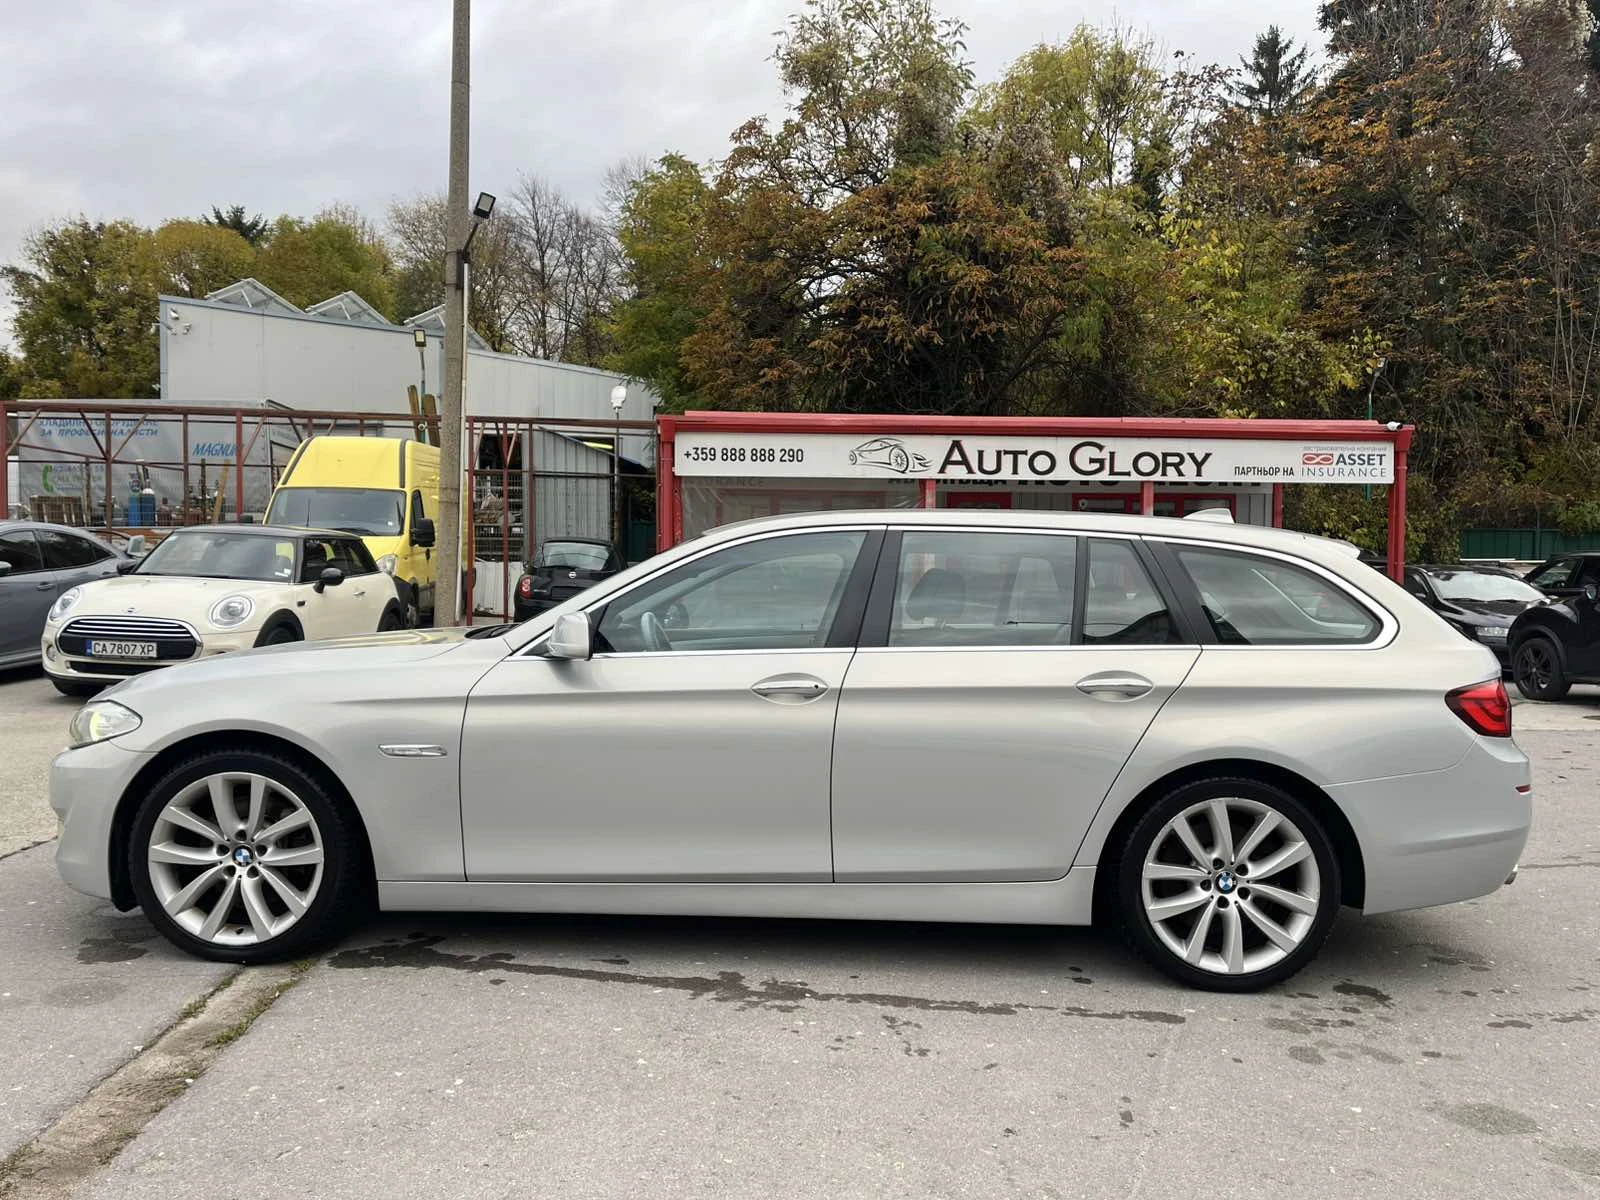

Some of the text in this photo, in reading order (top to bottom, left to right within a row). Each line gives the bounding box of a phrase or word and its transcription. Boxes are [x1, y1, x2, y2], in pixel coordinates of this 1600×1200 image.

[683, 447, 804, 463] +359 888 888 290
[1335, 452, 1387, 466] ASSET
[1234, 466, 1295, 477] ПАРТНЬОР НА
[1301, 466, 1387, 478] INSURANCE
[93, 642, 108, 655] CA
[109, 642, 137, 656] 7807
